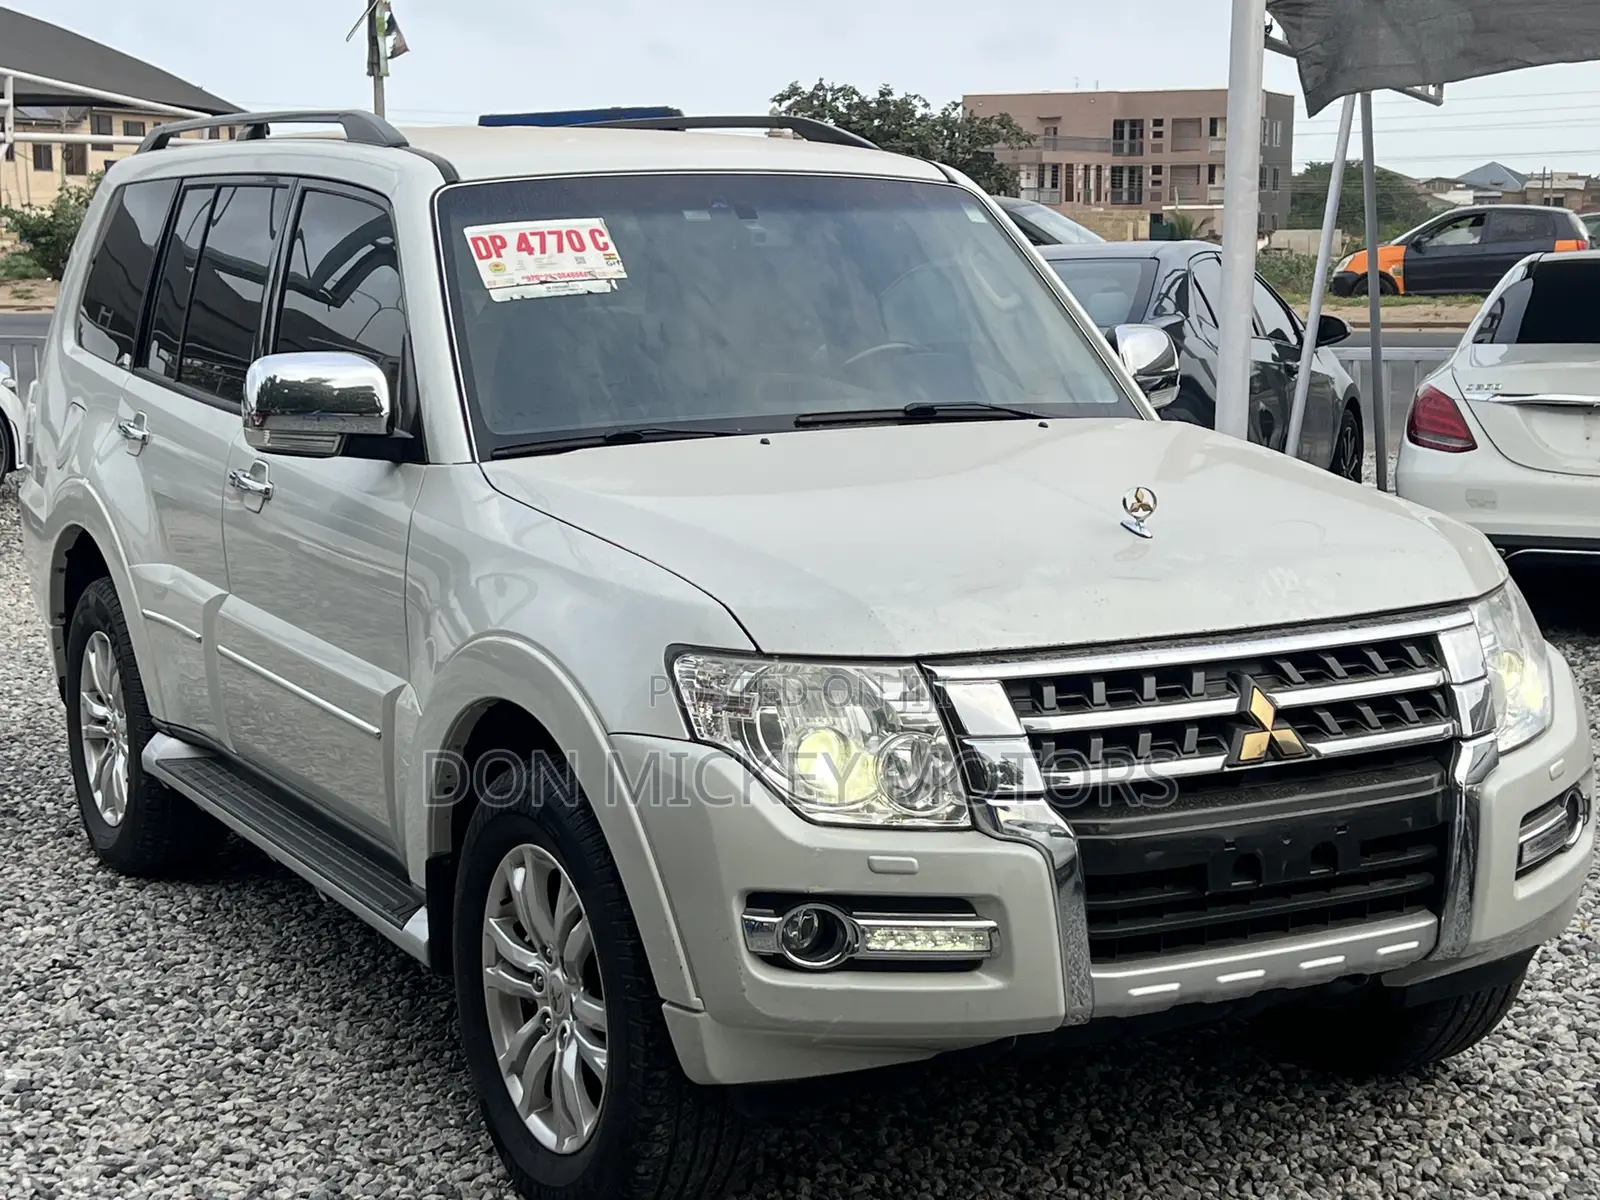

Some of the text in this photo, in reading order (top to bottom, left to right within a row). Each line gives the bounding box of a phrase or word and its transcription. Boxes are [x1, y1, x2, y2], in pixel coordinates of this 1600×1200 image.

[470, 228, 609, 260] DP 4770 C
